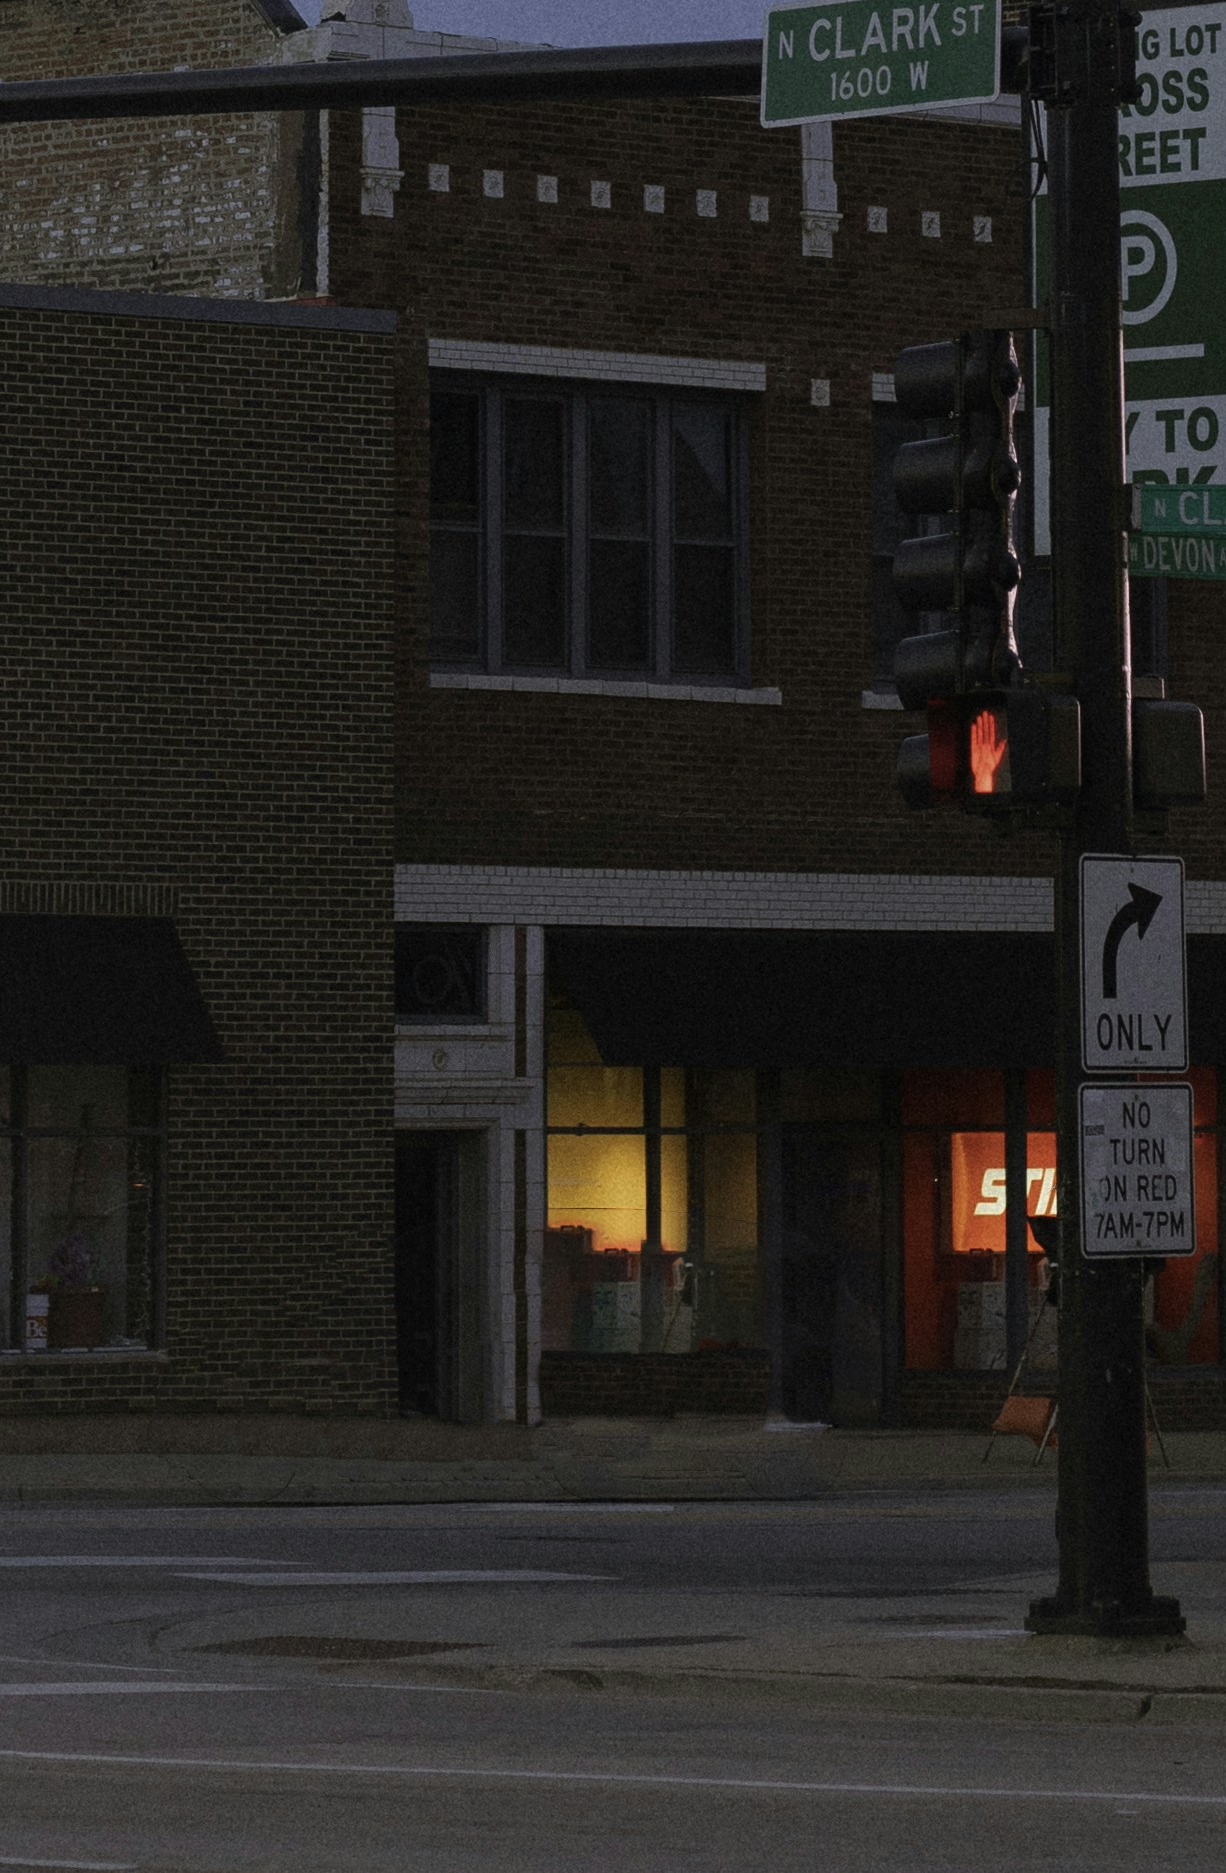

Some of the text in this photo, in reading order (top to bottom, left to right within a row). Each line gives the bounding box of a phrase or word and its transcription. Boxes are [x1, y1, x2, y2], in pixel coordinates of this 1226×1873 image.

[777, 3, 985, 62] N CLARK ST
[1135, 23, 1222, 61] G LOT
[830, 60, 929, 101] 1600 W
[1120, 67, 1210, 118] OSS
[1155, 406, 1219, 453] TO
[1154, 498, 1167, 518] N
[1129, 542, 1138, 562] W
[1142, 535, 1216, 574] DEVON
[1096, 1013, 1172, 1052] ONLY
[1122, 1101, 1151, 1129] NO
[1109, 1138, 1165, 1165] TURN
[1099, 1175, 1177, 1202] ON RED
[1093, 1211, 1185, 1239] 7AM-7PM
